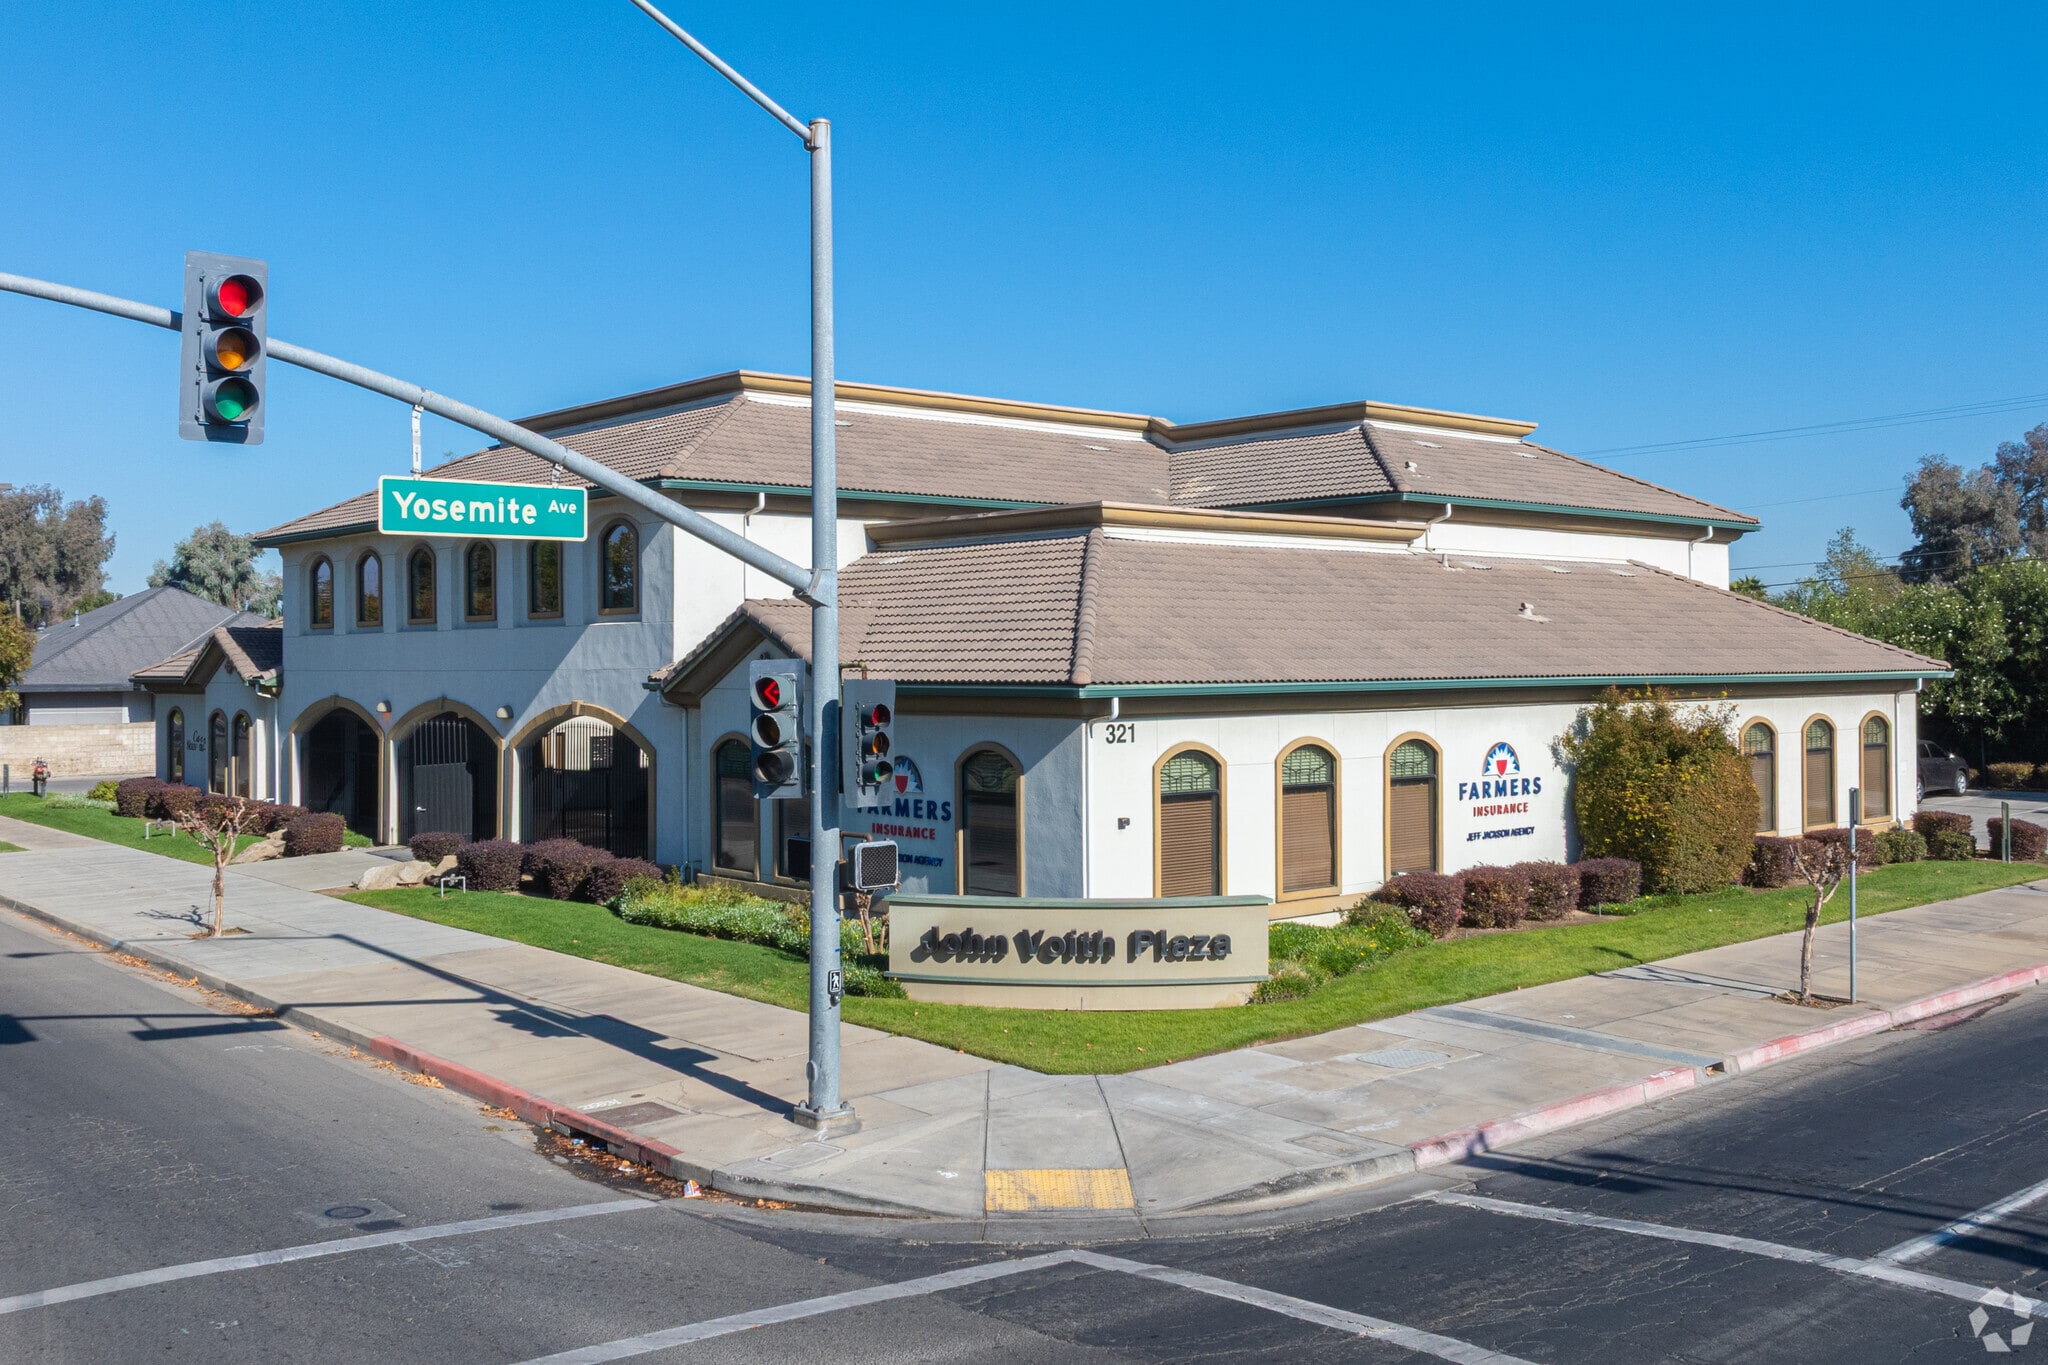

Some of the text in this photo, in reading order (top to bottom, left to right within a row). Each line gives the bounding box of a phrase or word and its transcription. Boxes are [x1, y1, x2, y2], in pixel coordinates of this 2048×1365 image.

[392, 491, 577, 525] Yosemite Ave
[1106, 723, 1135, 744] 321
[1459, 777, 1542, 801] FARMERS
[1473, 802, 1528, 817] INSURANCE
[872, 823, 936, 841] INSURANCE
[916, 926, 1232, 959] John Voith Plaza
